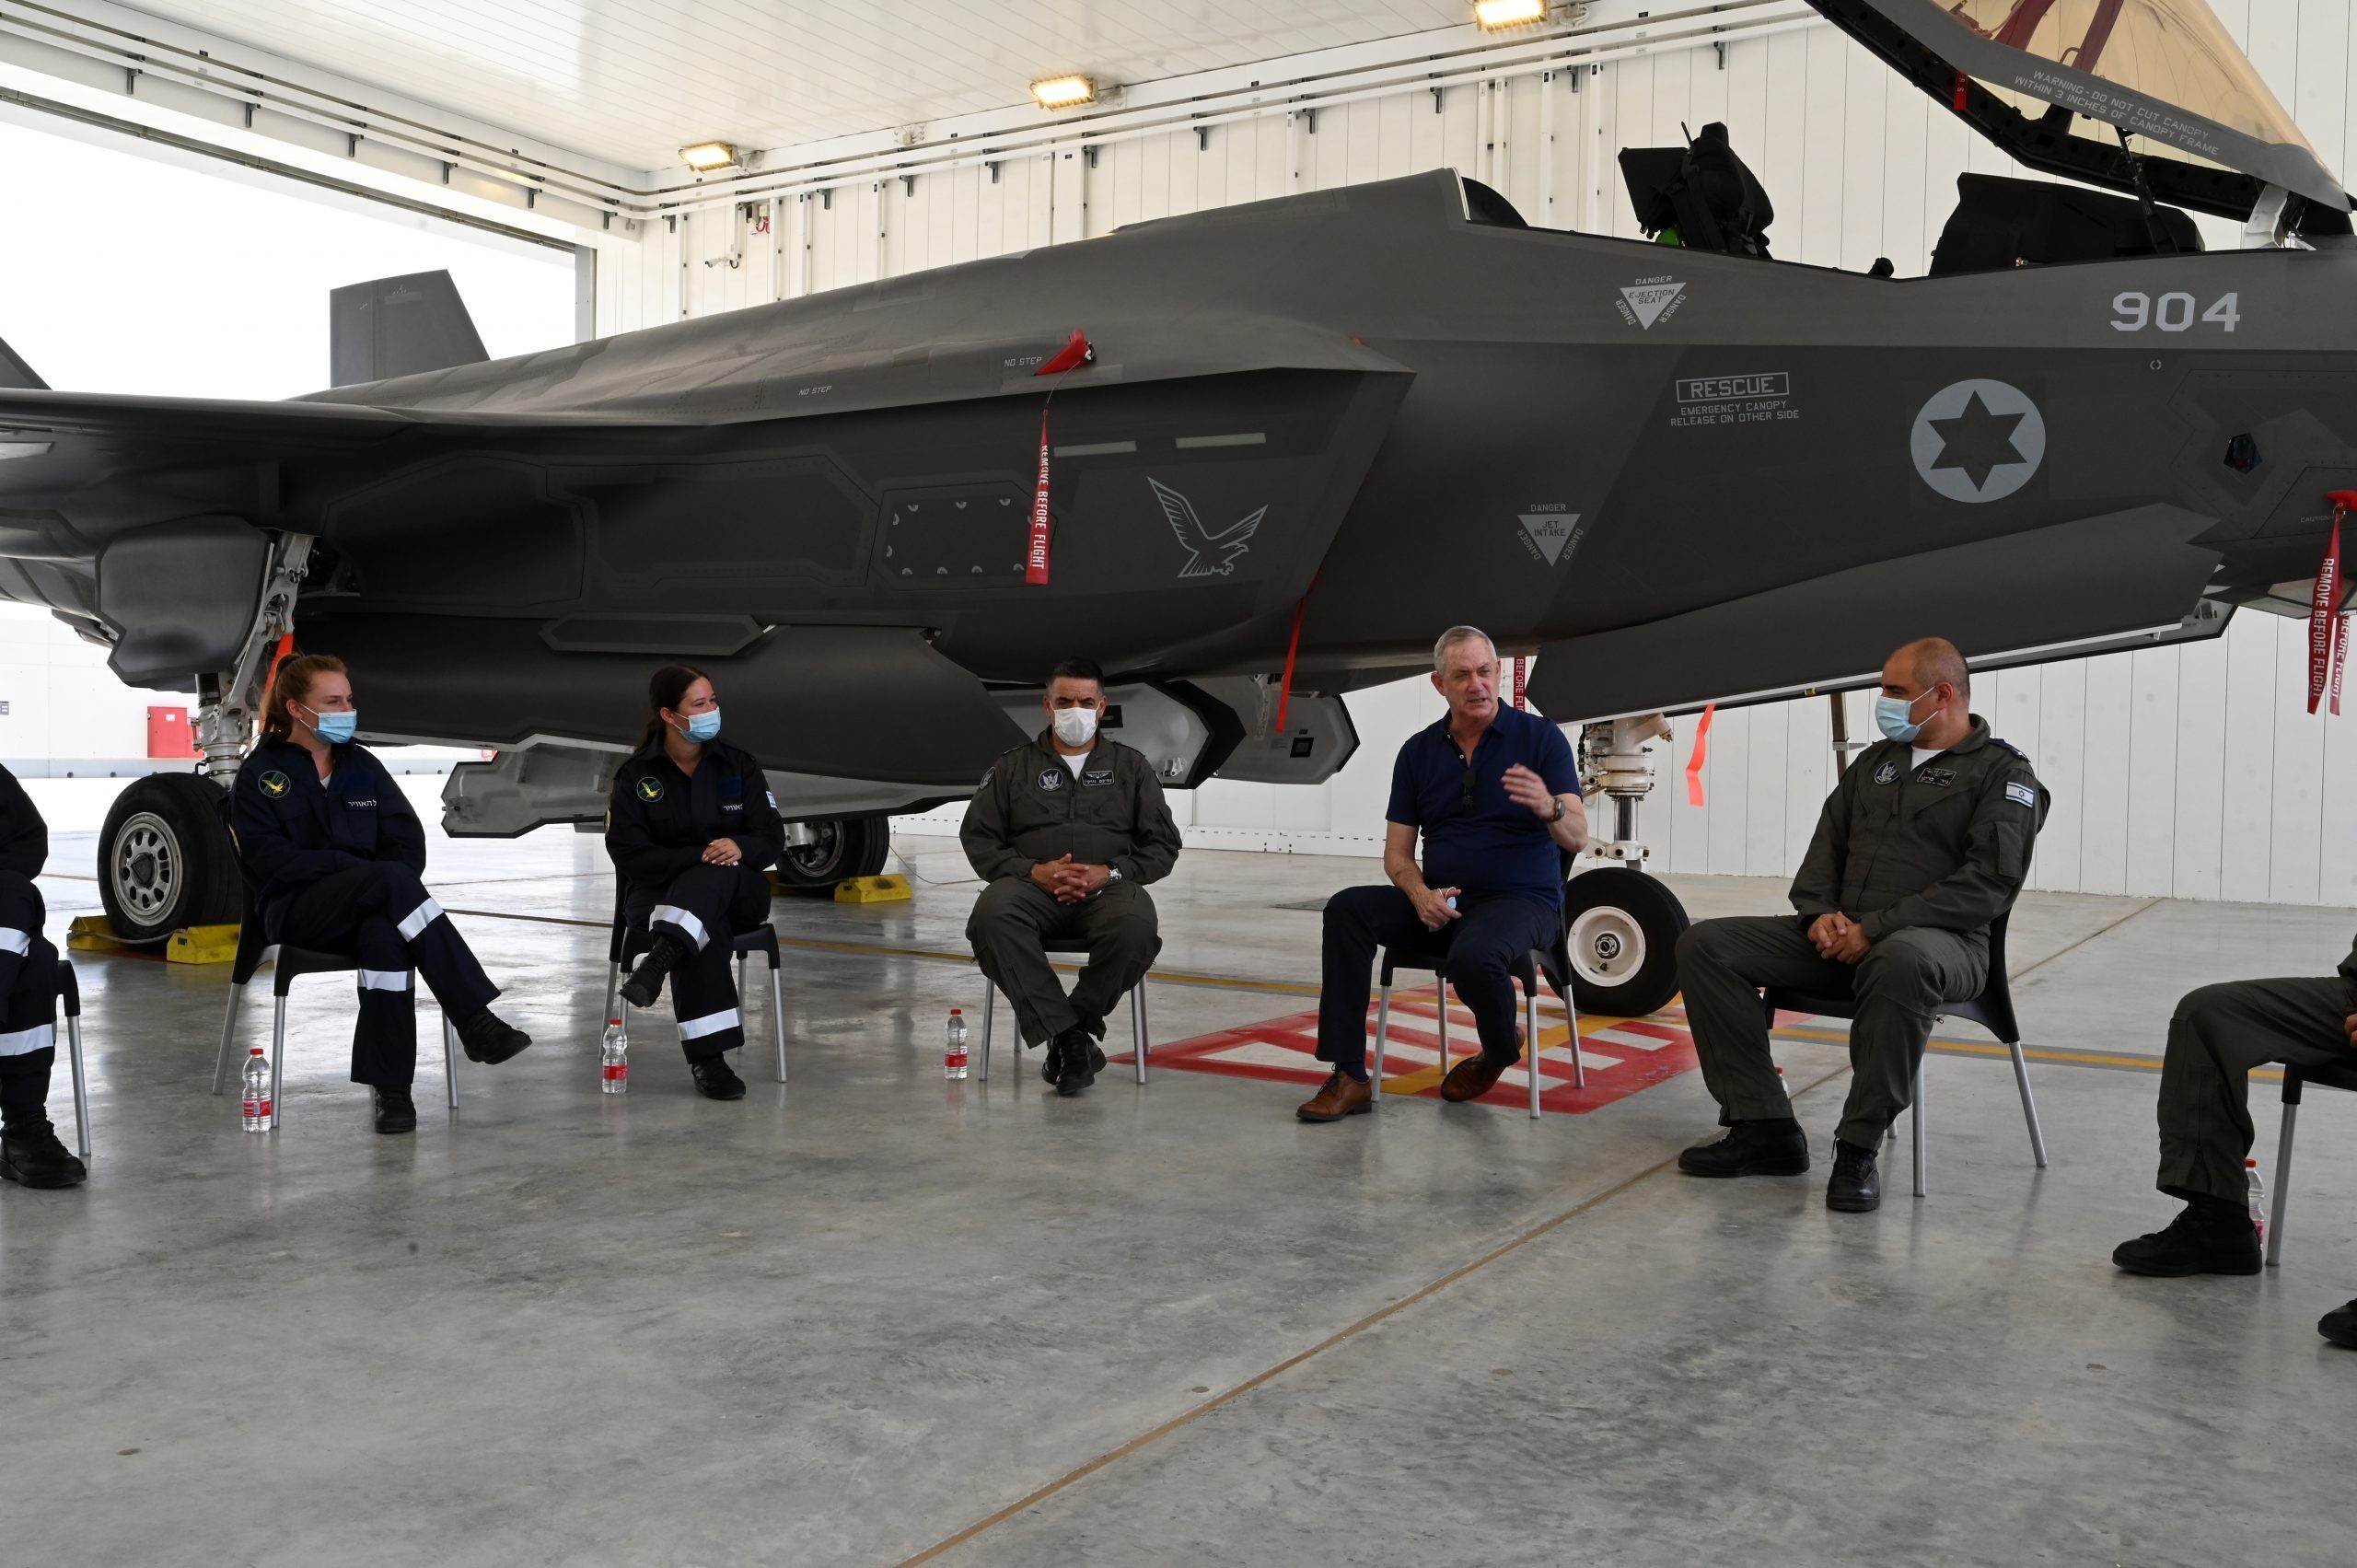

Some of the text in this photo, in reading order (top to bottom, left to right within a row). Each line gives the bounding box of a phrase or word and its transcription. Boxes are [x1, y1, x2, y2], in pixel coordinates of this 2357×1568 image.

[2014, 75, 2220, 156] WITHIN 3 INCHES OF CANOPY FRAME
[2111, 99, 2134, 111] NOT
[2138, 108, 2160, 122] CUT
[2164, 117, 2209, 138] CANOPY
[1629, 289, 1674, 298] EJECTION
[1635, 276, 1672, 285] DANGER
[1616, 298, 1636, 326] DANGER
[1659, 295, 1687, 323] DANGER
[2110, 292, 2240, 331] 904
[1004, 357, 1042, 367] NO STEP
[811, 386, 832, 394] STEP
[1690, 377, 1774, 398] RESCUE
[1670, 410, 1800, 426] RELEASE ON OTHER SIDE
[1681, 400, 1786, 415] EMERGENCY CANOPY
[1036, 491, 1048, 528] BEFORE
[1530, 504, 1566, 512] DANGER
[1535, 528, 1566, 537] INTAKE
[1542, 520, 1559, 528] JET
[1032, 534, 1046, 570] FLIGHT
[1517, 528, 1541, 561] DANGER
[1562, 528, 1584, 561] DANGER
[2313, 558, 2335, 697] REMOVE BEFORE FLIGHT
[1515, 659, 1524, 693] BEFORE
